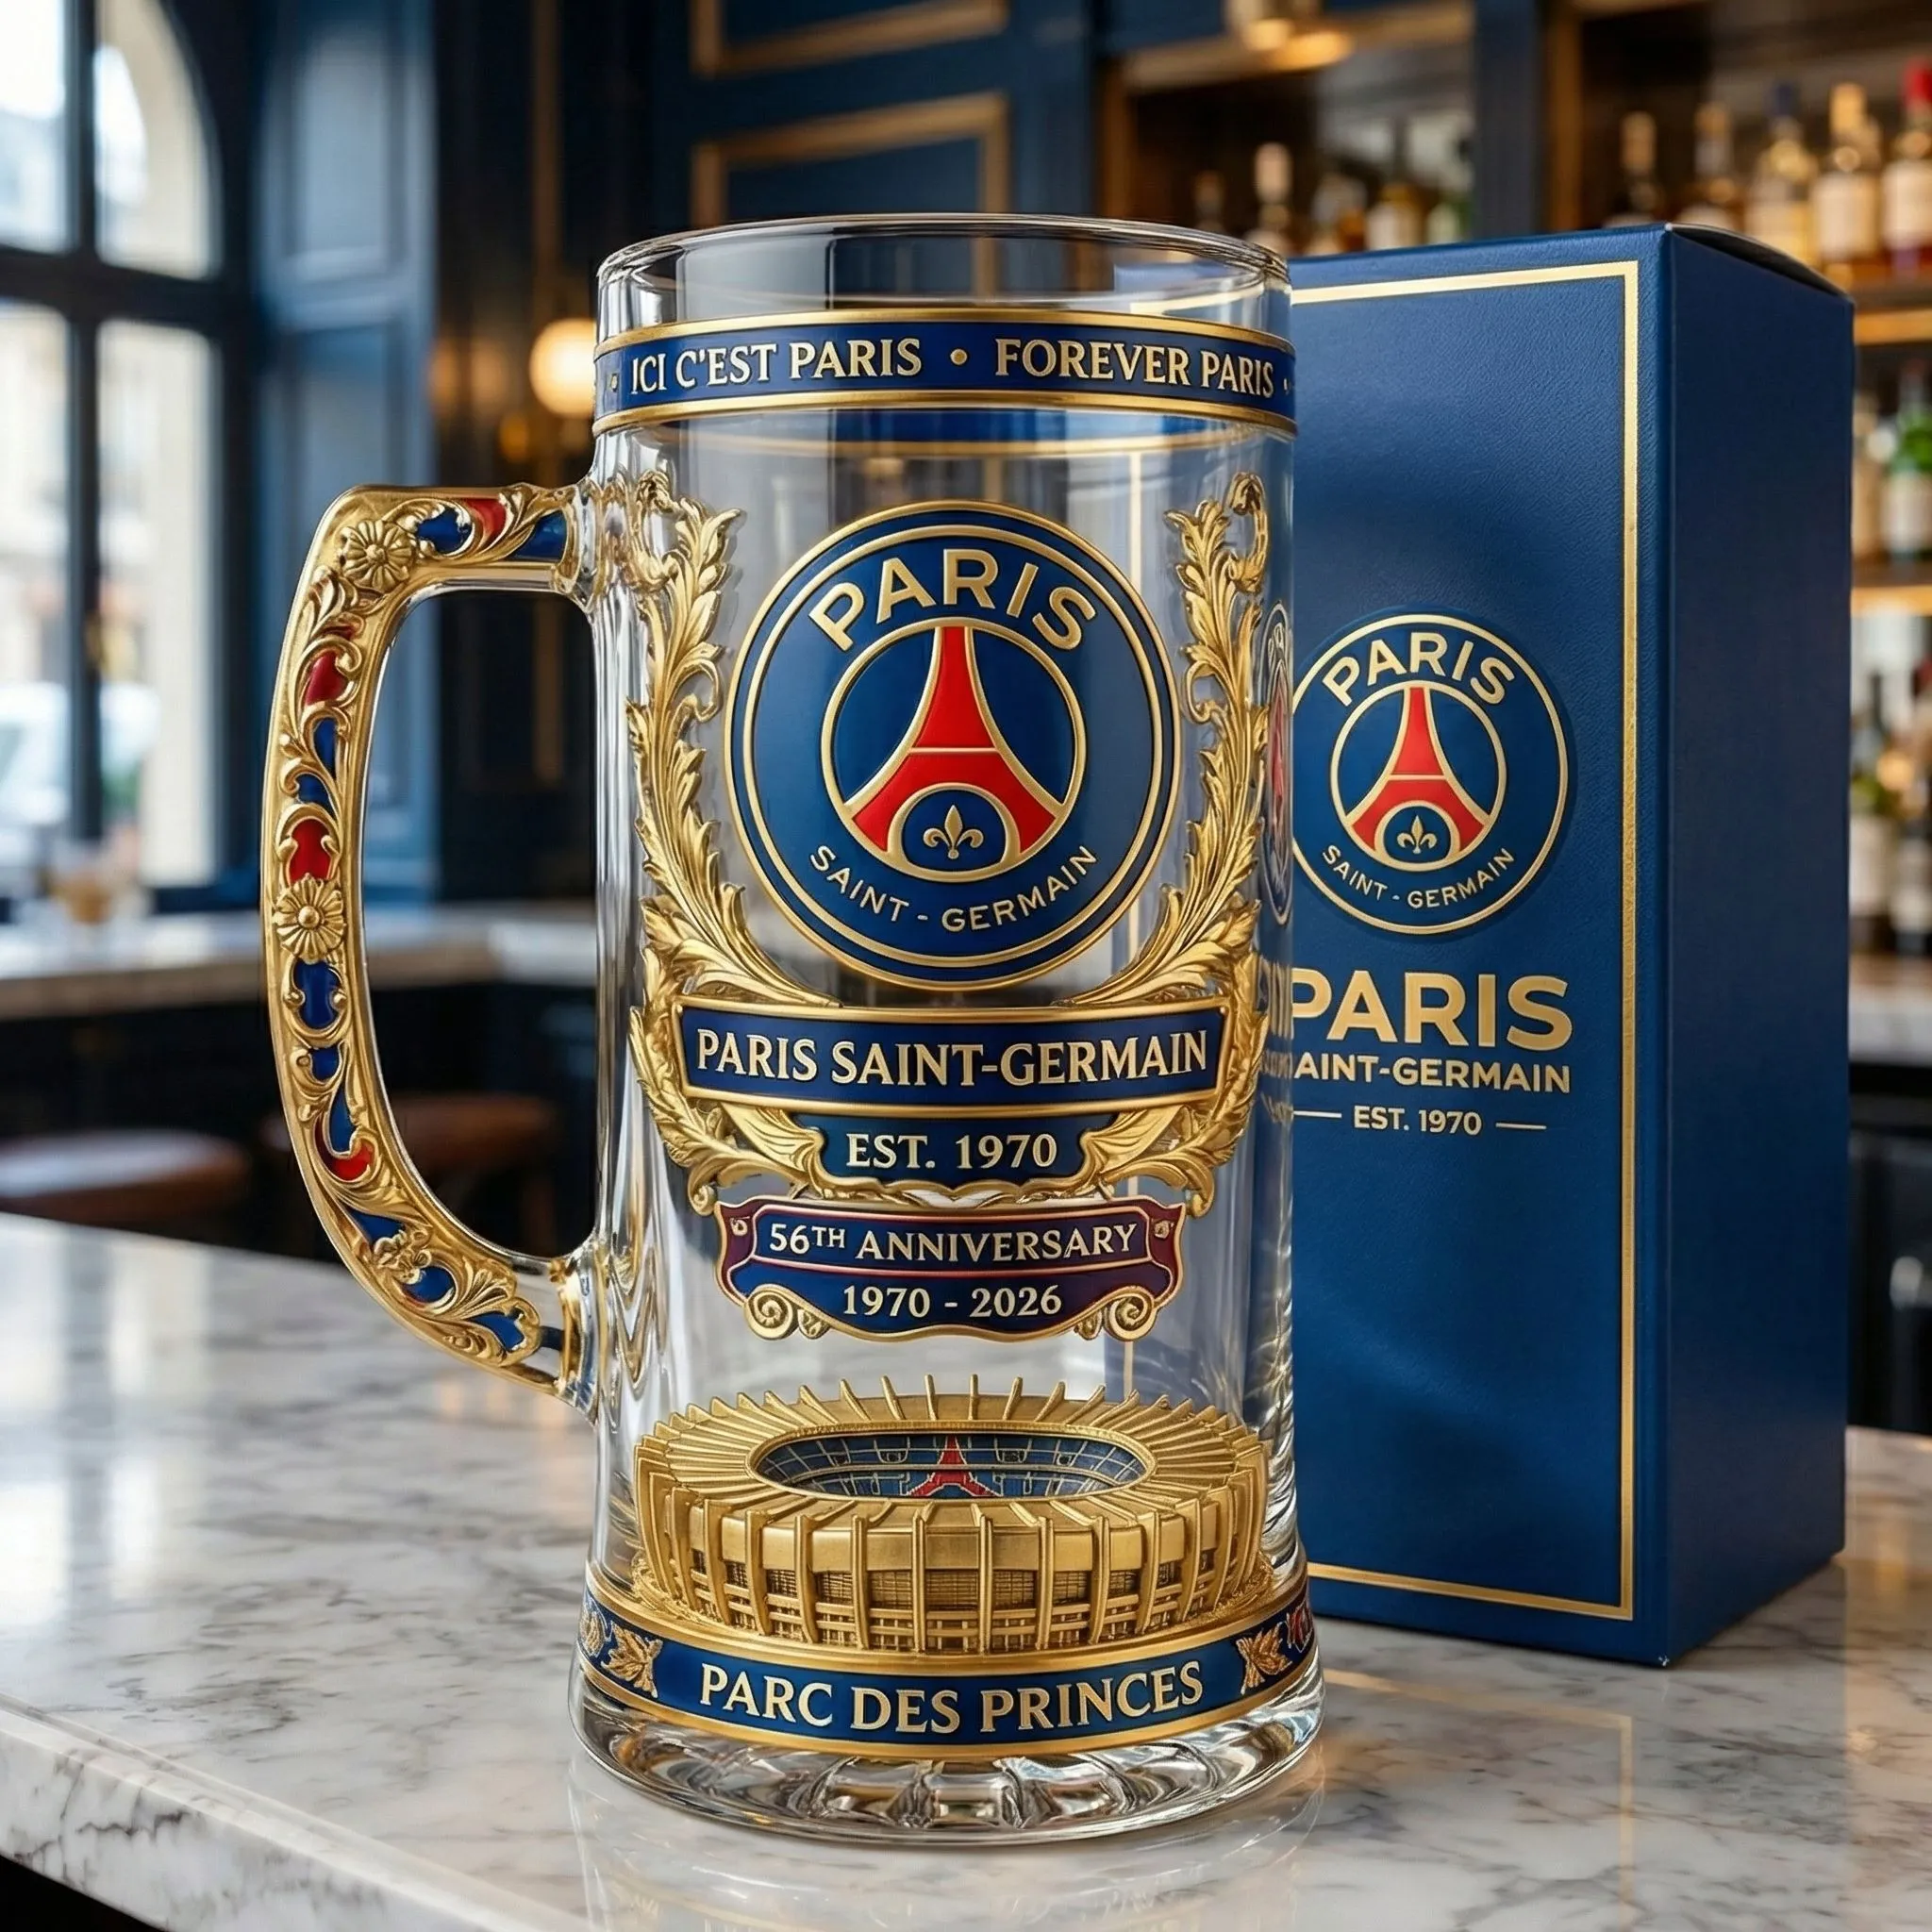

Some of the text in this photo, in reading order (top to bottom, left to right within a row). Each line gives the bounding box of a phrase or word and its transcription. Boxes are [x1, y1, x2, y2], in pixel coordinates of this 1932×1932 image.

[631, 338, 1274, 398] ICI C'EST PARIS FOREVER PARIS
[808, 548, 1097, 652] PARIS
[1322, 632, 1515, 707] PARIS
[810, 844, 909, 923] SAINT
[941, 846, 1098, 934] GERMAIN
[1323, 844, 1388, 901] SAINT
[1407, 848, 1515, 908] GERMAIN
[1291, 967, 1574, 1052] PARIS
[697, 1028, 1208, 1087] PARIS SAINT-GERMAIN
[1293, 1052, 1571, 1093] AINT-GERMAIN
[1354, 1105, 1482, 1136] EST. 1970
[846, 1133, 1057, 1170] EST. 1970
[770, 1224, 1138, 1262] 56TH ANNIVERSARY
[843, 1285, 930, 1318] 1970
[970, 1284, 1061, 1318] 2026
[700, 1660, 1203, 1733] PARC DES PRINCES
